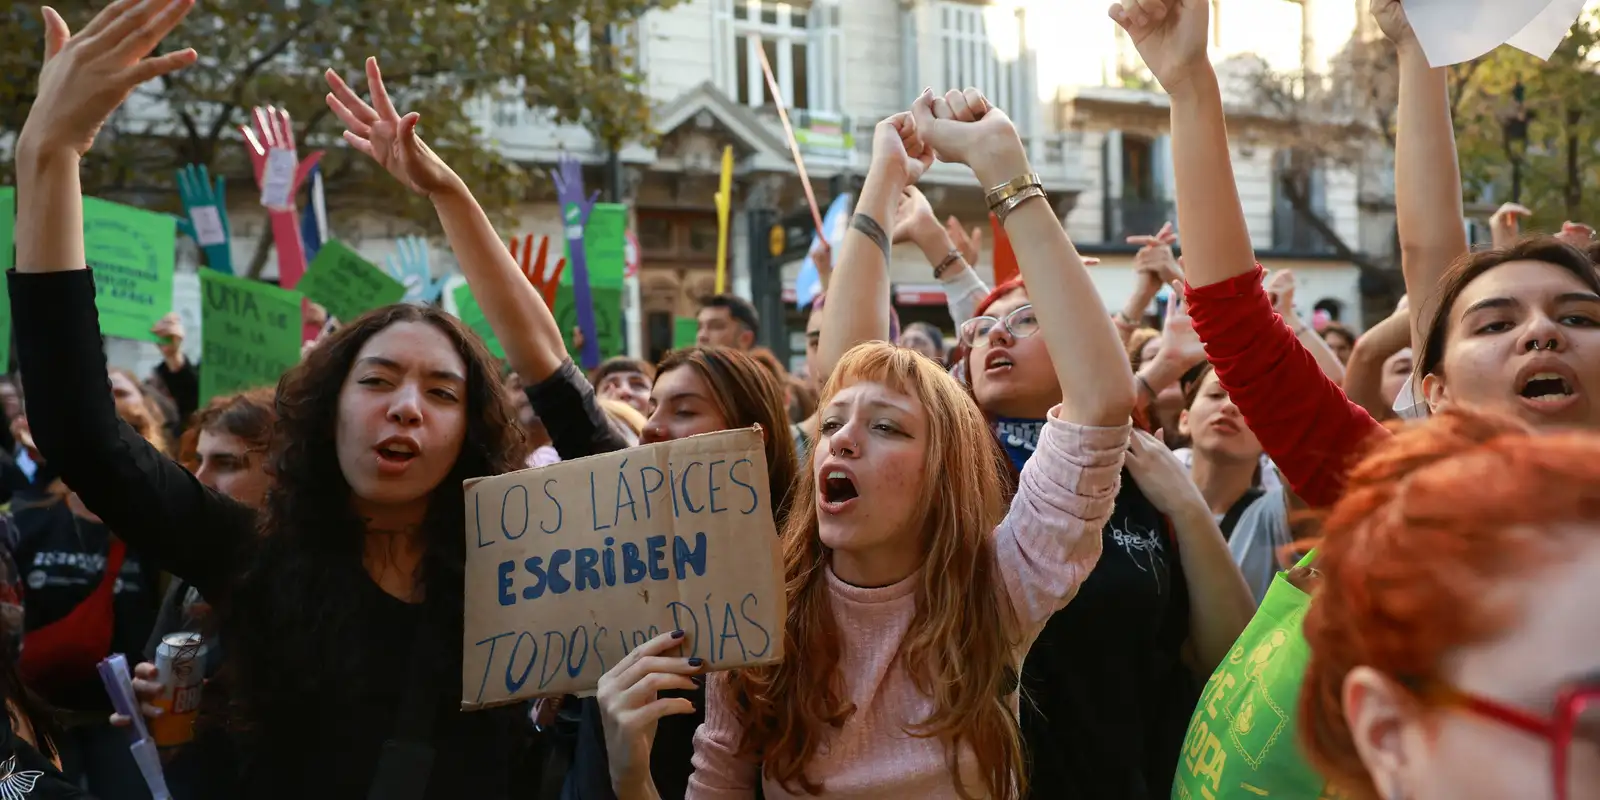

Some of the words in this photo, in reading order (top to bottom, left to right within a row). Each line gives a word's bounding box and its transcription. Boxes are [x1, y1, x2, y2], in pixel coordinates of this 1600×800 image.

[475, 478, 563, 548] LOS
[590, 458, 758, 531] LÁPICES
[497, 531, 708, 606] ESCRIBEN
[475, 625, 607, 703] TODOS
[666, 592, 770, 663] DÍAS
